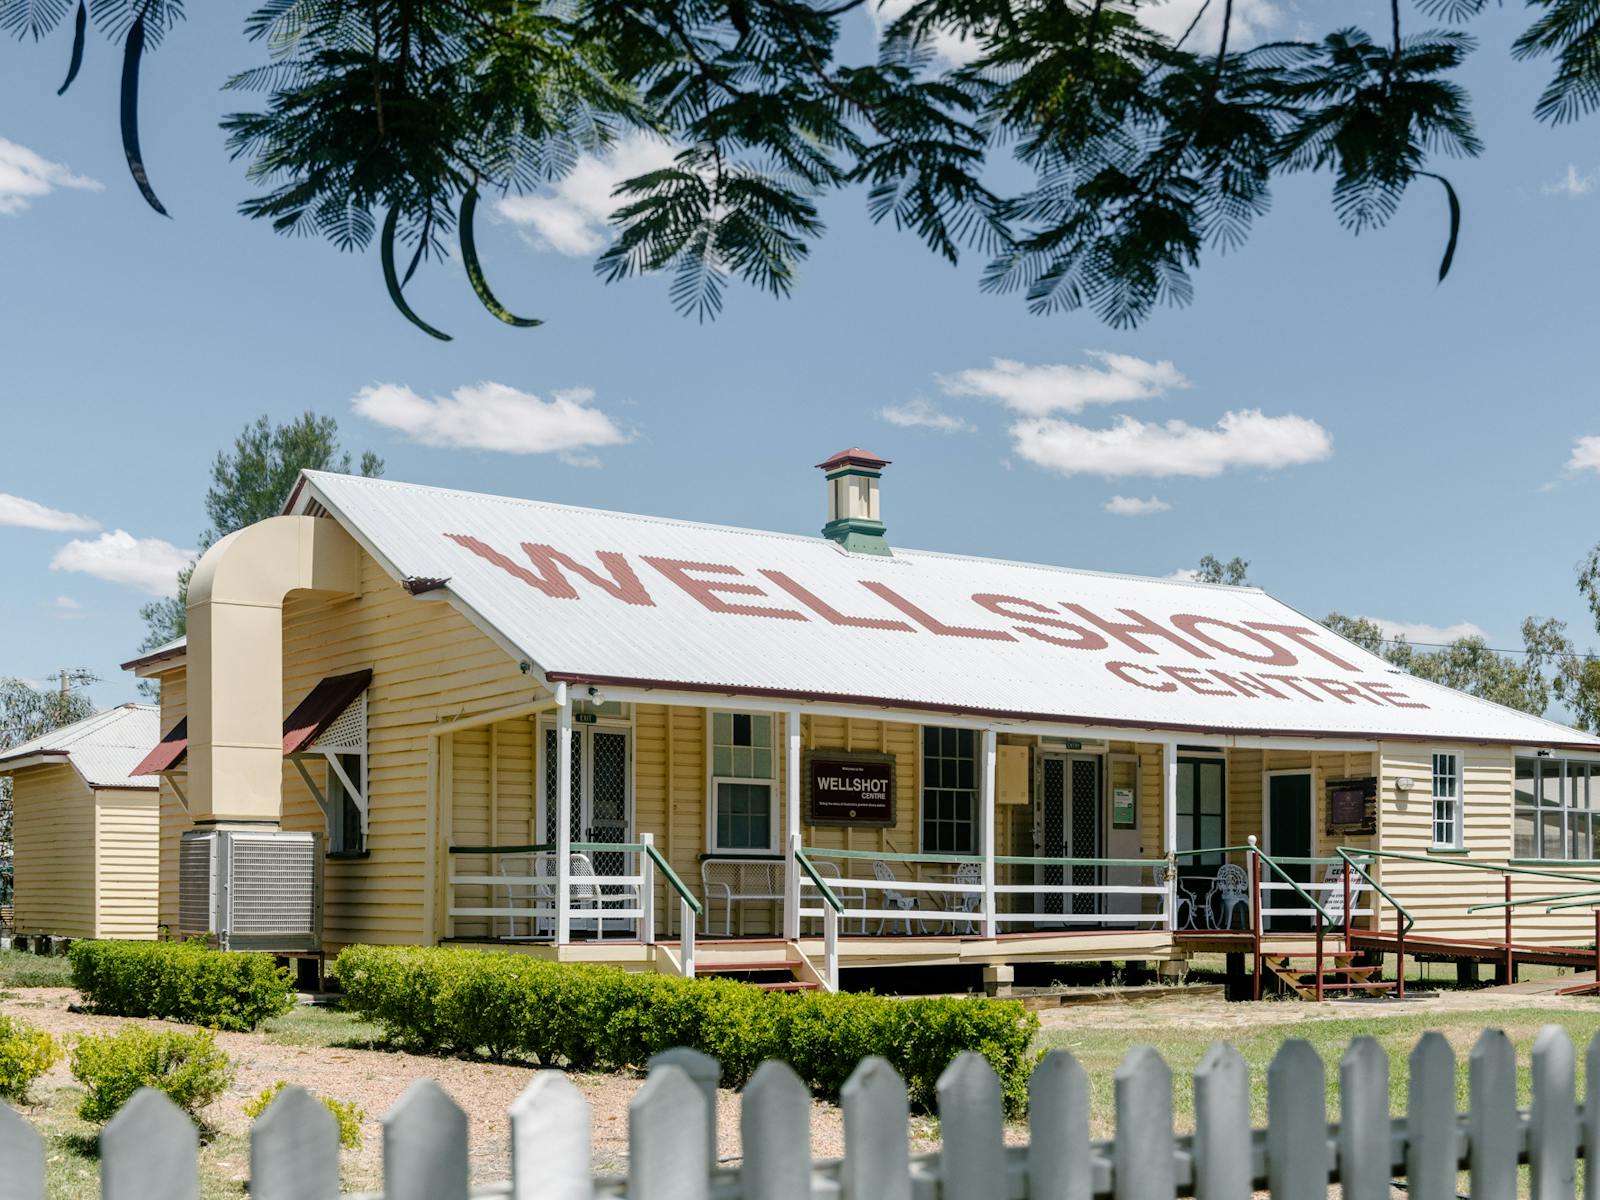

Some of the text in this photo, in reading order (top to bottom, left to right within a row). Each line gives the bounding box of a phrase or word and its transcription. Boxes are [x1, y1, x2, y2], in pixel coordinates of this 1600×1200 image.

[443, 533, 1363, 672] WELLSHOT
[1105, 661, 1430, 709] CENTRE
[817, 777, 888, 792] WELLSHOT
[861, 792, 886, 800] CENTRE
